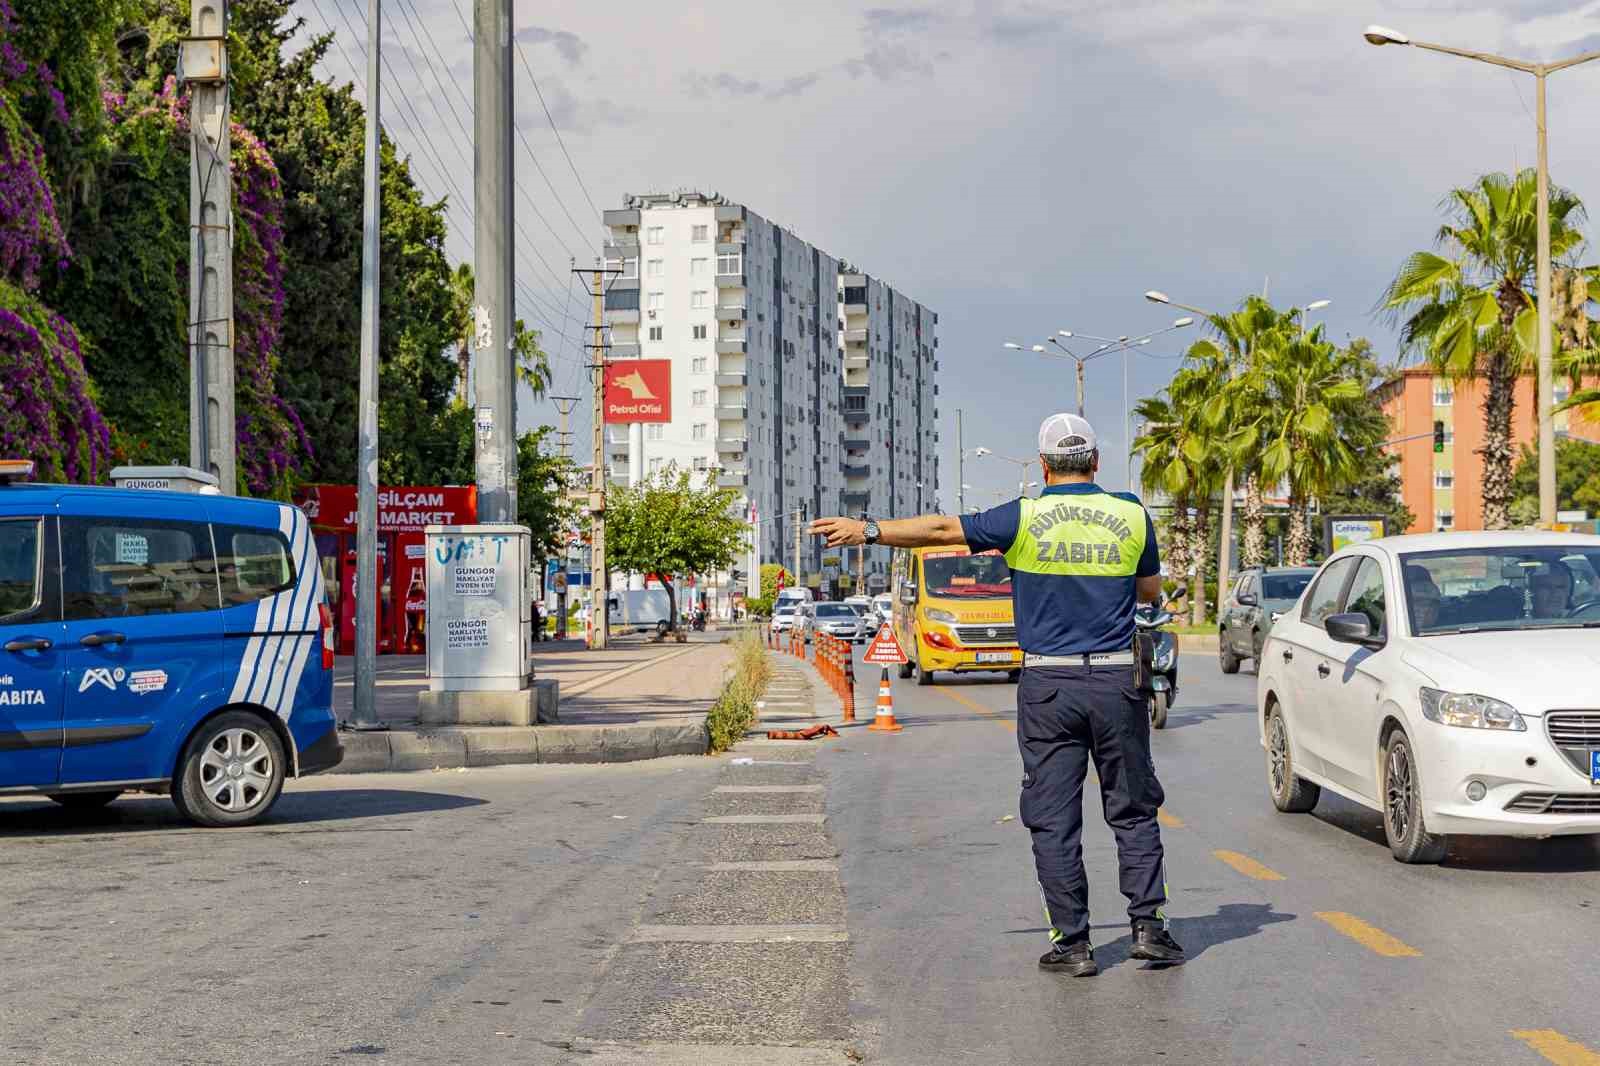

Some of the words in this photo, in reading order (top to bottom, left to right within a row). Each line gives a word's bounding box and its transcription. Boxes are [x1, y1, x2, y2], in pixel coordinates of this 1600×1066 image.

[609, 404, 637, 414] Petrol
[639, 404, 661, 414] Ofisi
[355, 490, 444, 508] ŞİLÇAM
[380, 512, 455, 525] MARKET
[1028, 503, 1132, 542] BÜYÜKŞEHİR
[1037, 541, 1122, 564] ZABITA
[0, 689, 46, 705] ABITA
